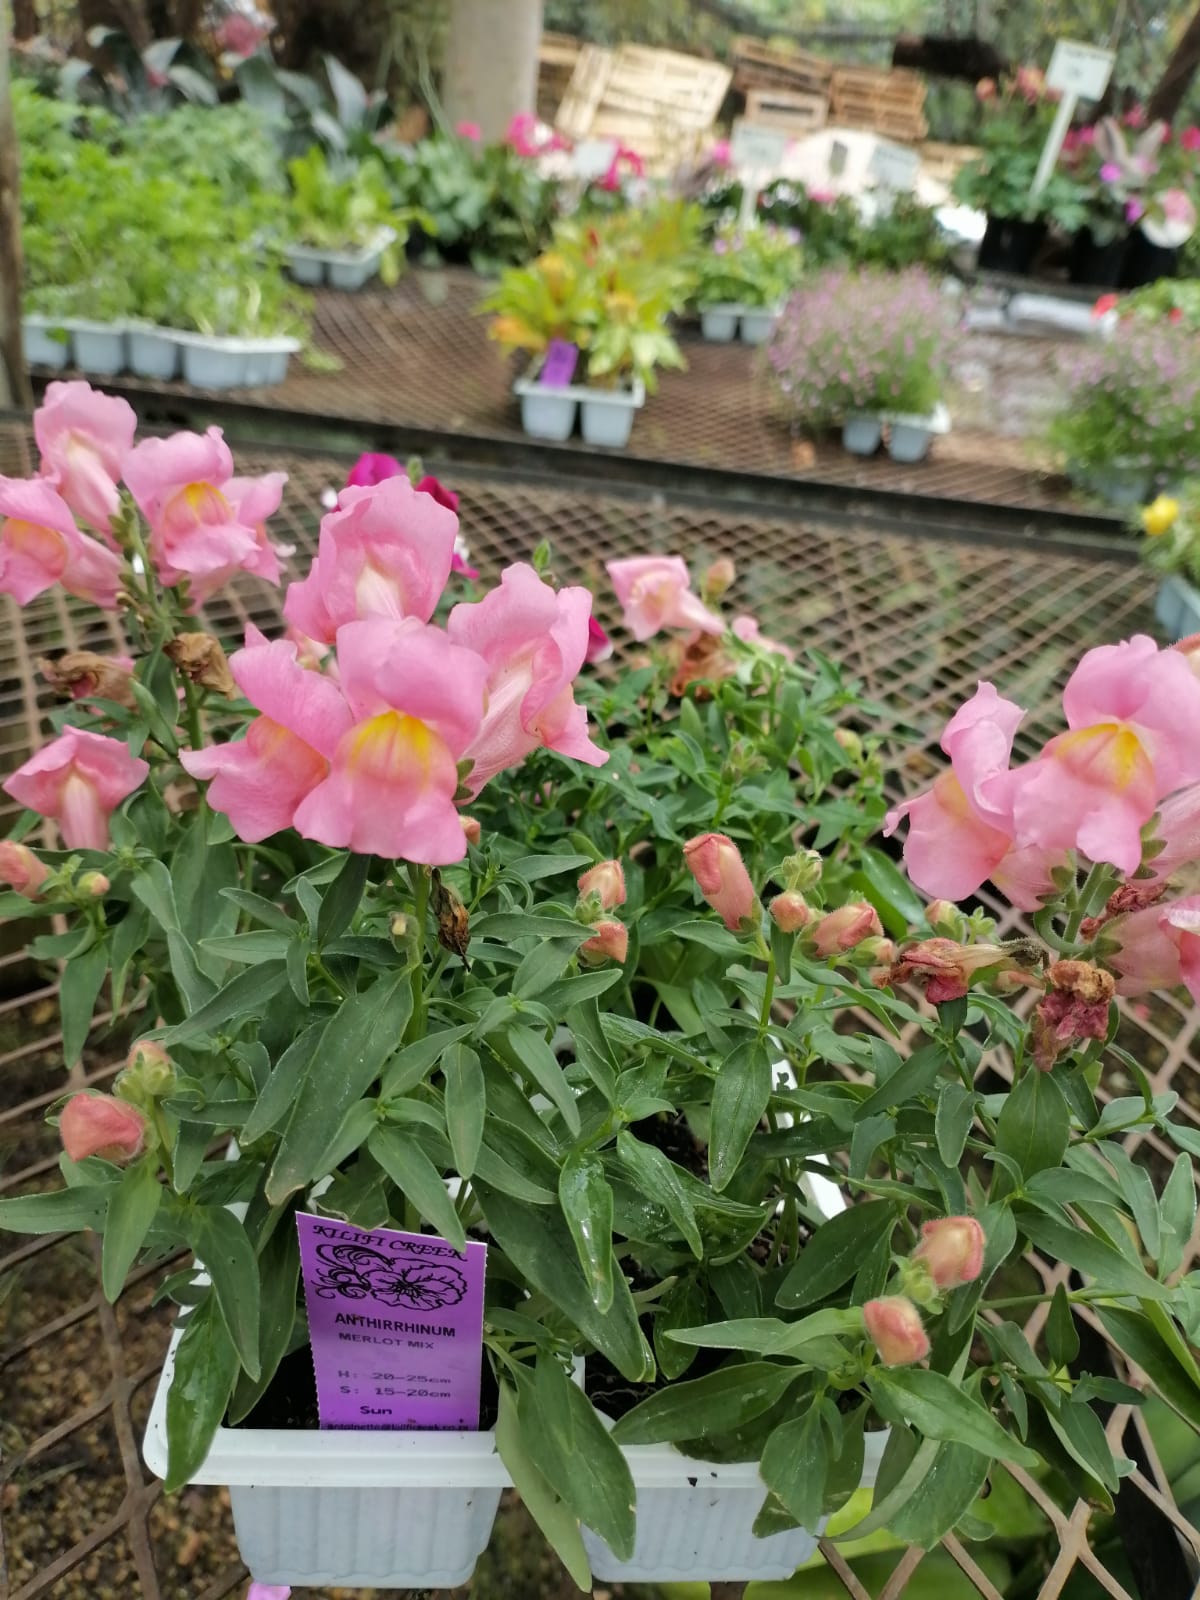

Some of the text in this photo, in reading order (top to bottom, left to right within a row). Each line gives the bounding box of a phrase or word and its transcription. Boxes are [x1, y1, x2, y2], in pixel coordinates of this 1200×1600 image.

[312, 1225, 387, 1247] KILIFI
[335, 1312, 456, 1338] ANTHIRRHINUM
[338, 1332, 435, 1349] MERLOT MIX
[371, 1372, 452, 1384] 20-25cm
[375, 1387, 452, 1398] 15-20cm
[360, 1405, 393, 1415] Sun
